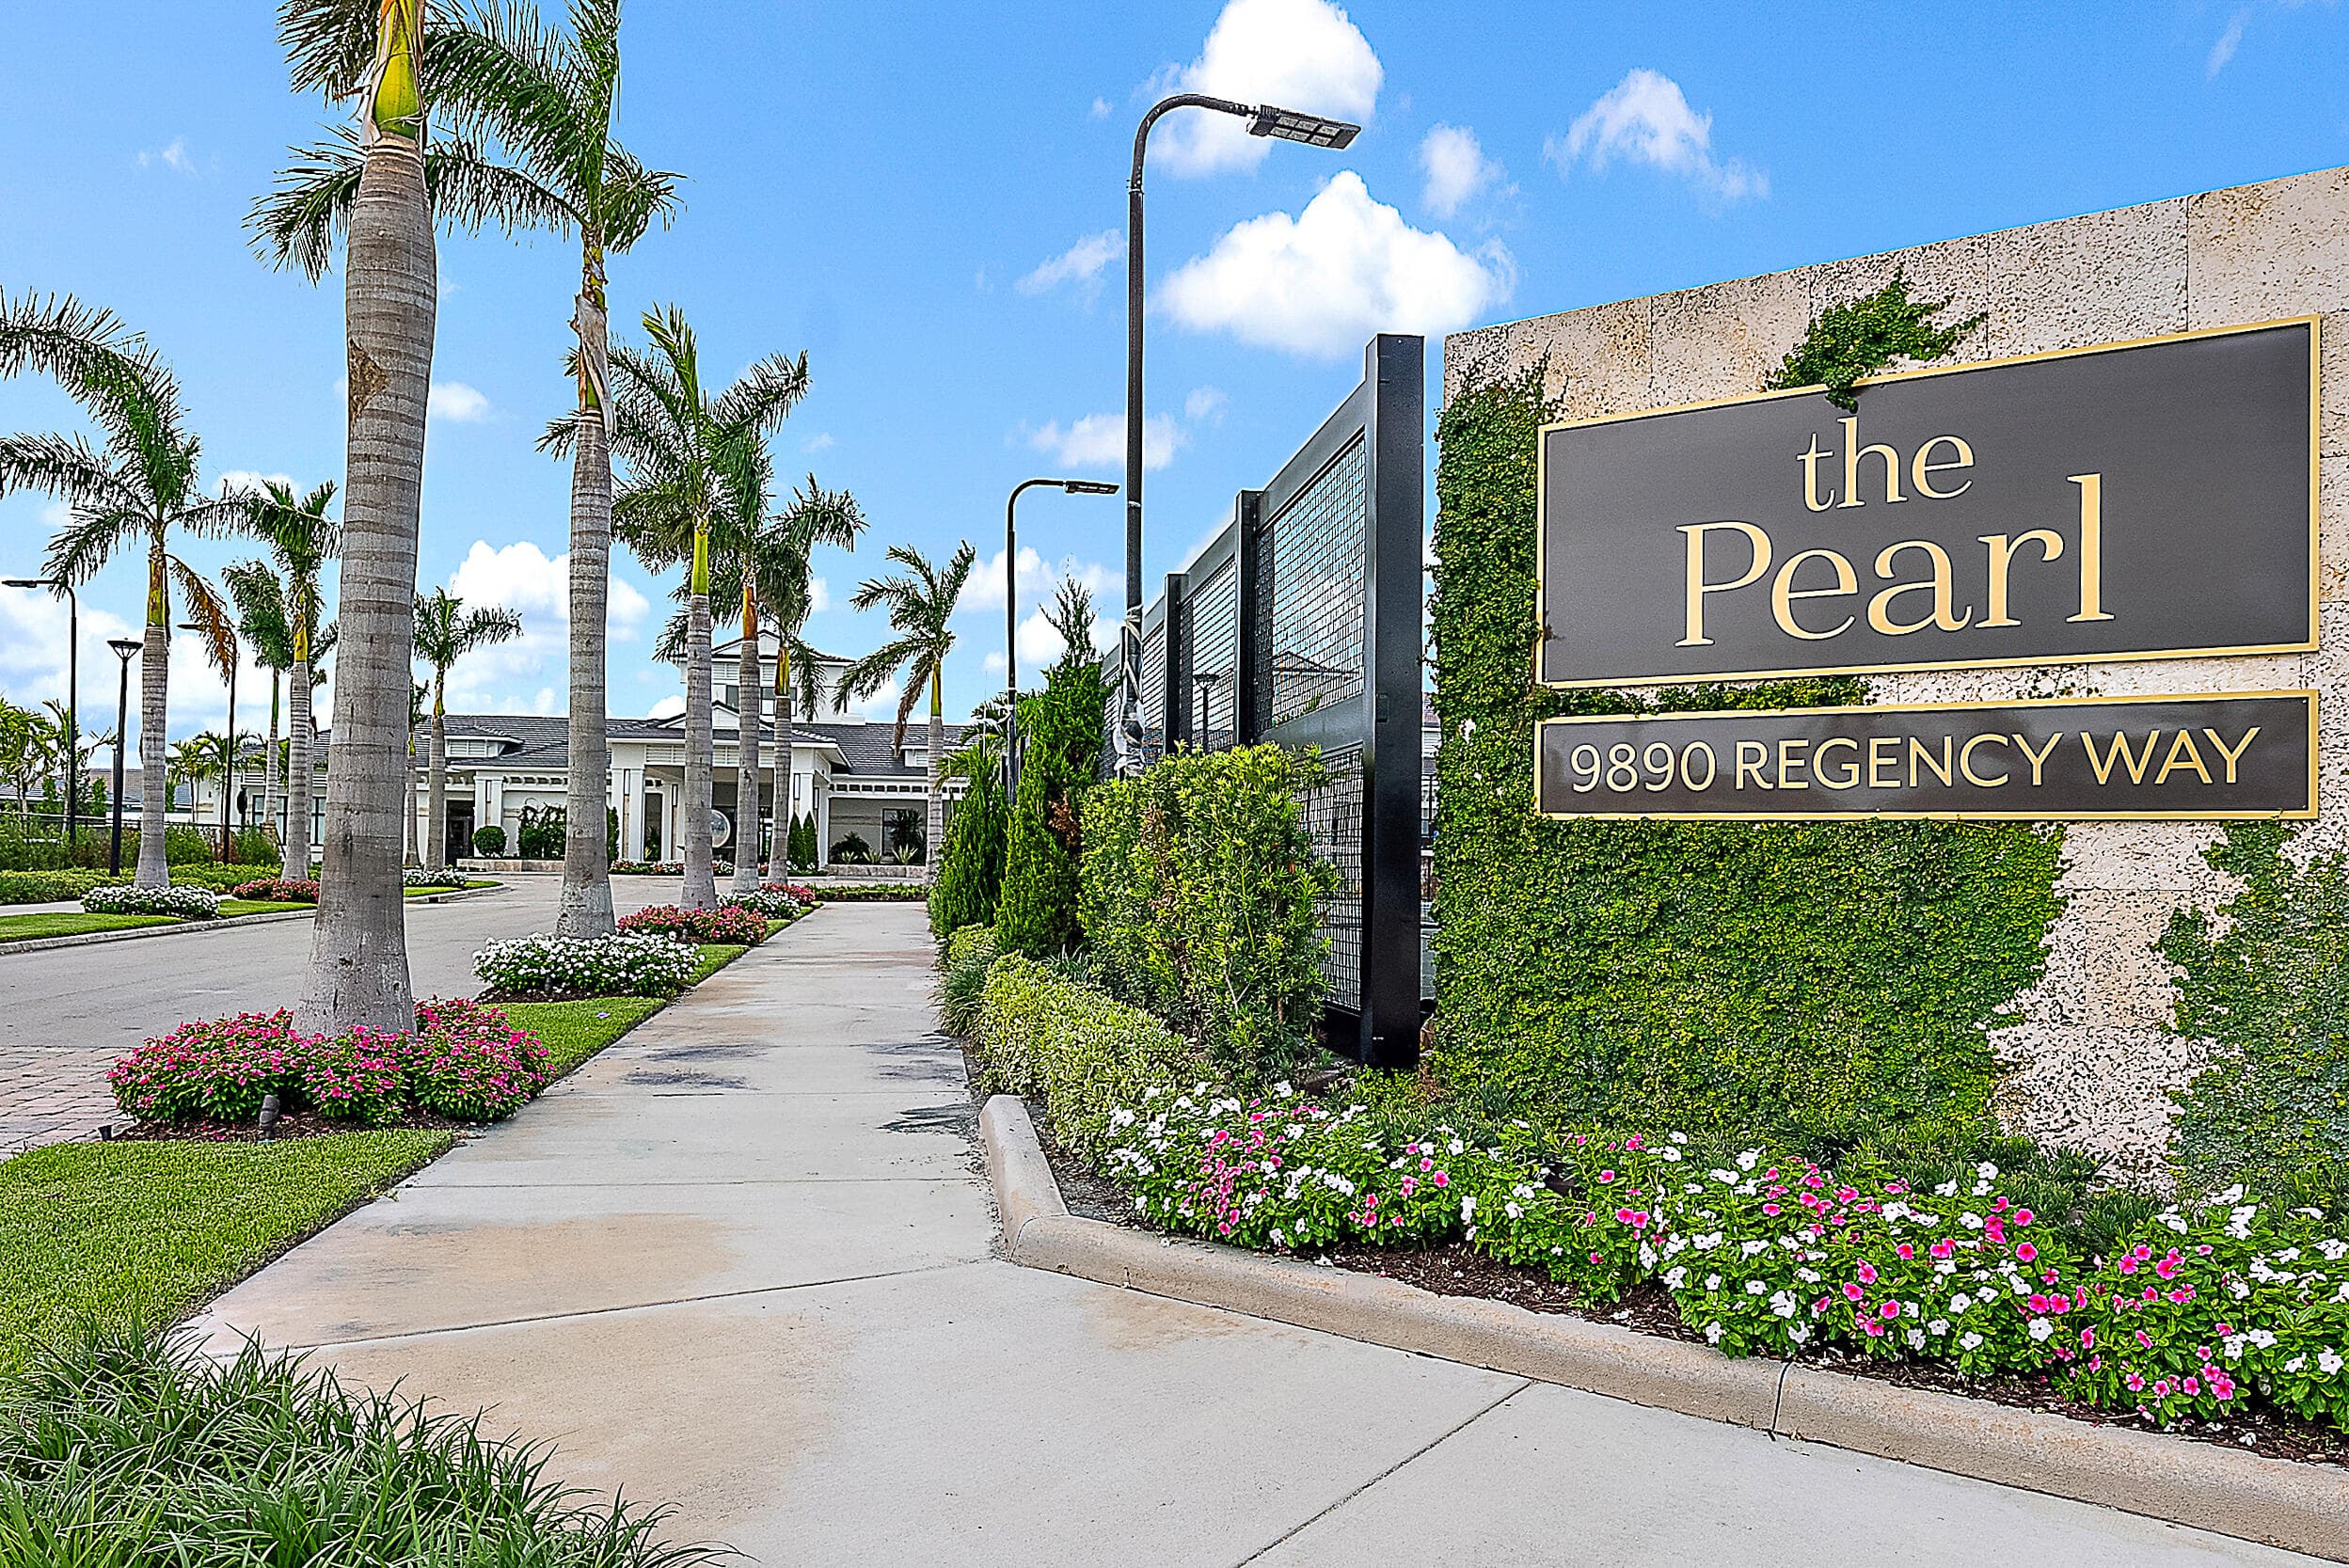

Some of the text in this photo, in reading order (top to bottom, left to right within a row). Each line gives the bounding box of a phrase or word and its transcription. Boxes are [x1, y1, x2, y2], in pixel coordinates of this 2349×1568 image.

[1797, 416, 1975, 513] the
[1674, 473, 2116, 647] Pearl
[1570, 726, 2262, 793] 9890 REGENCY WAY
